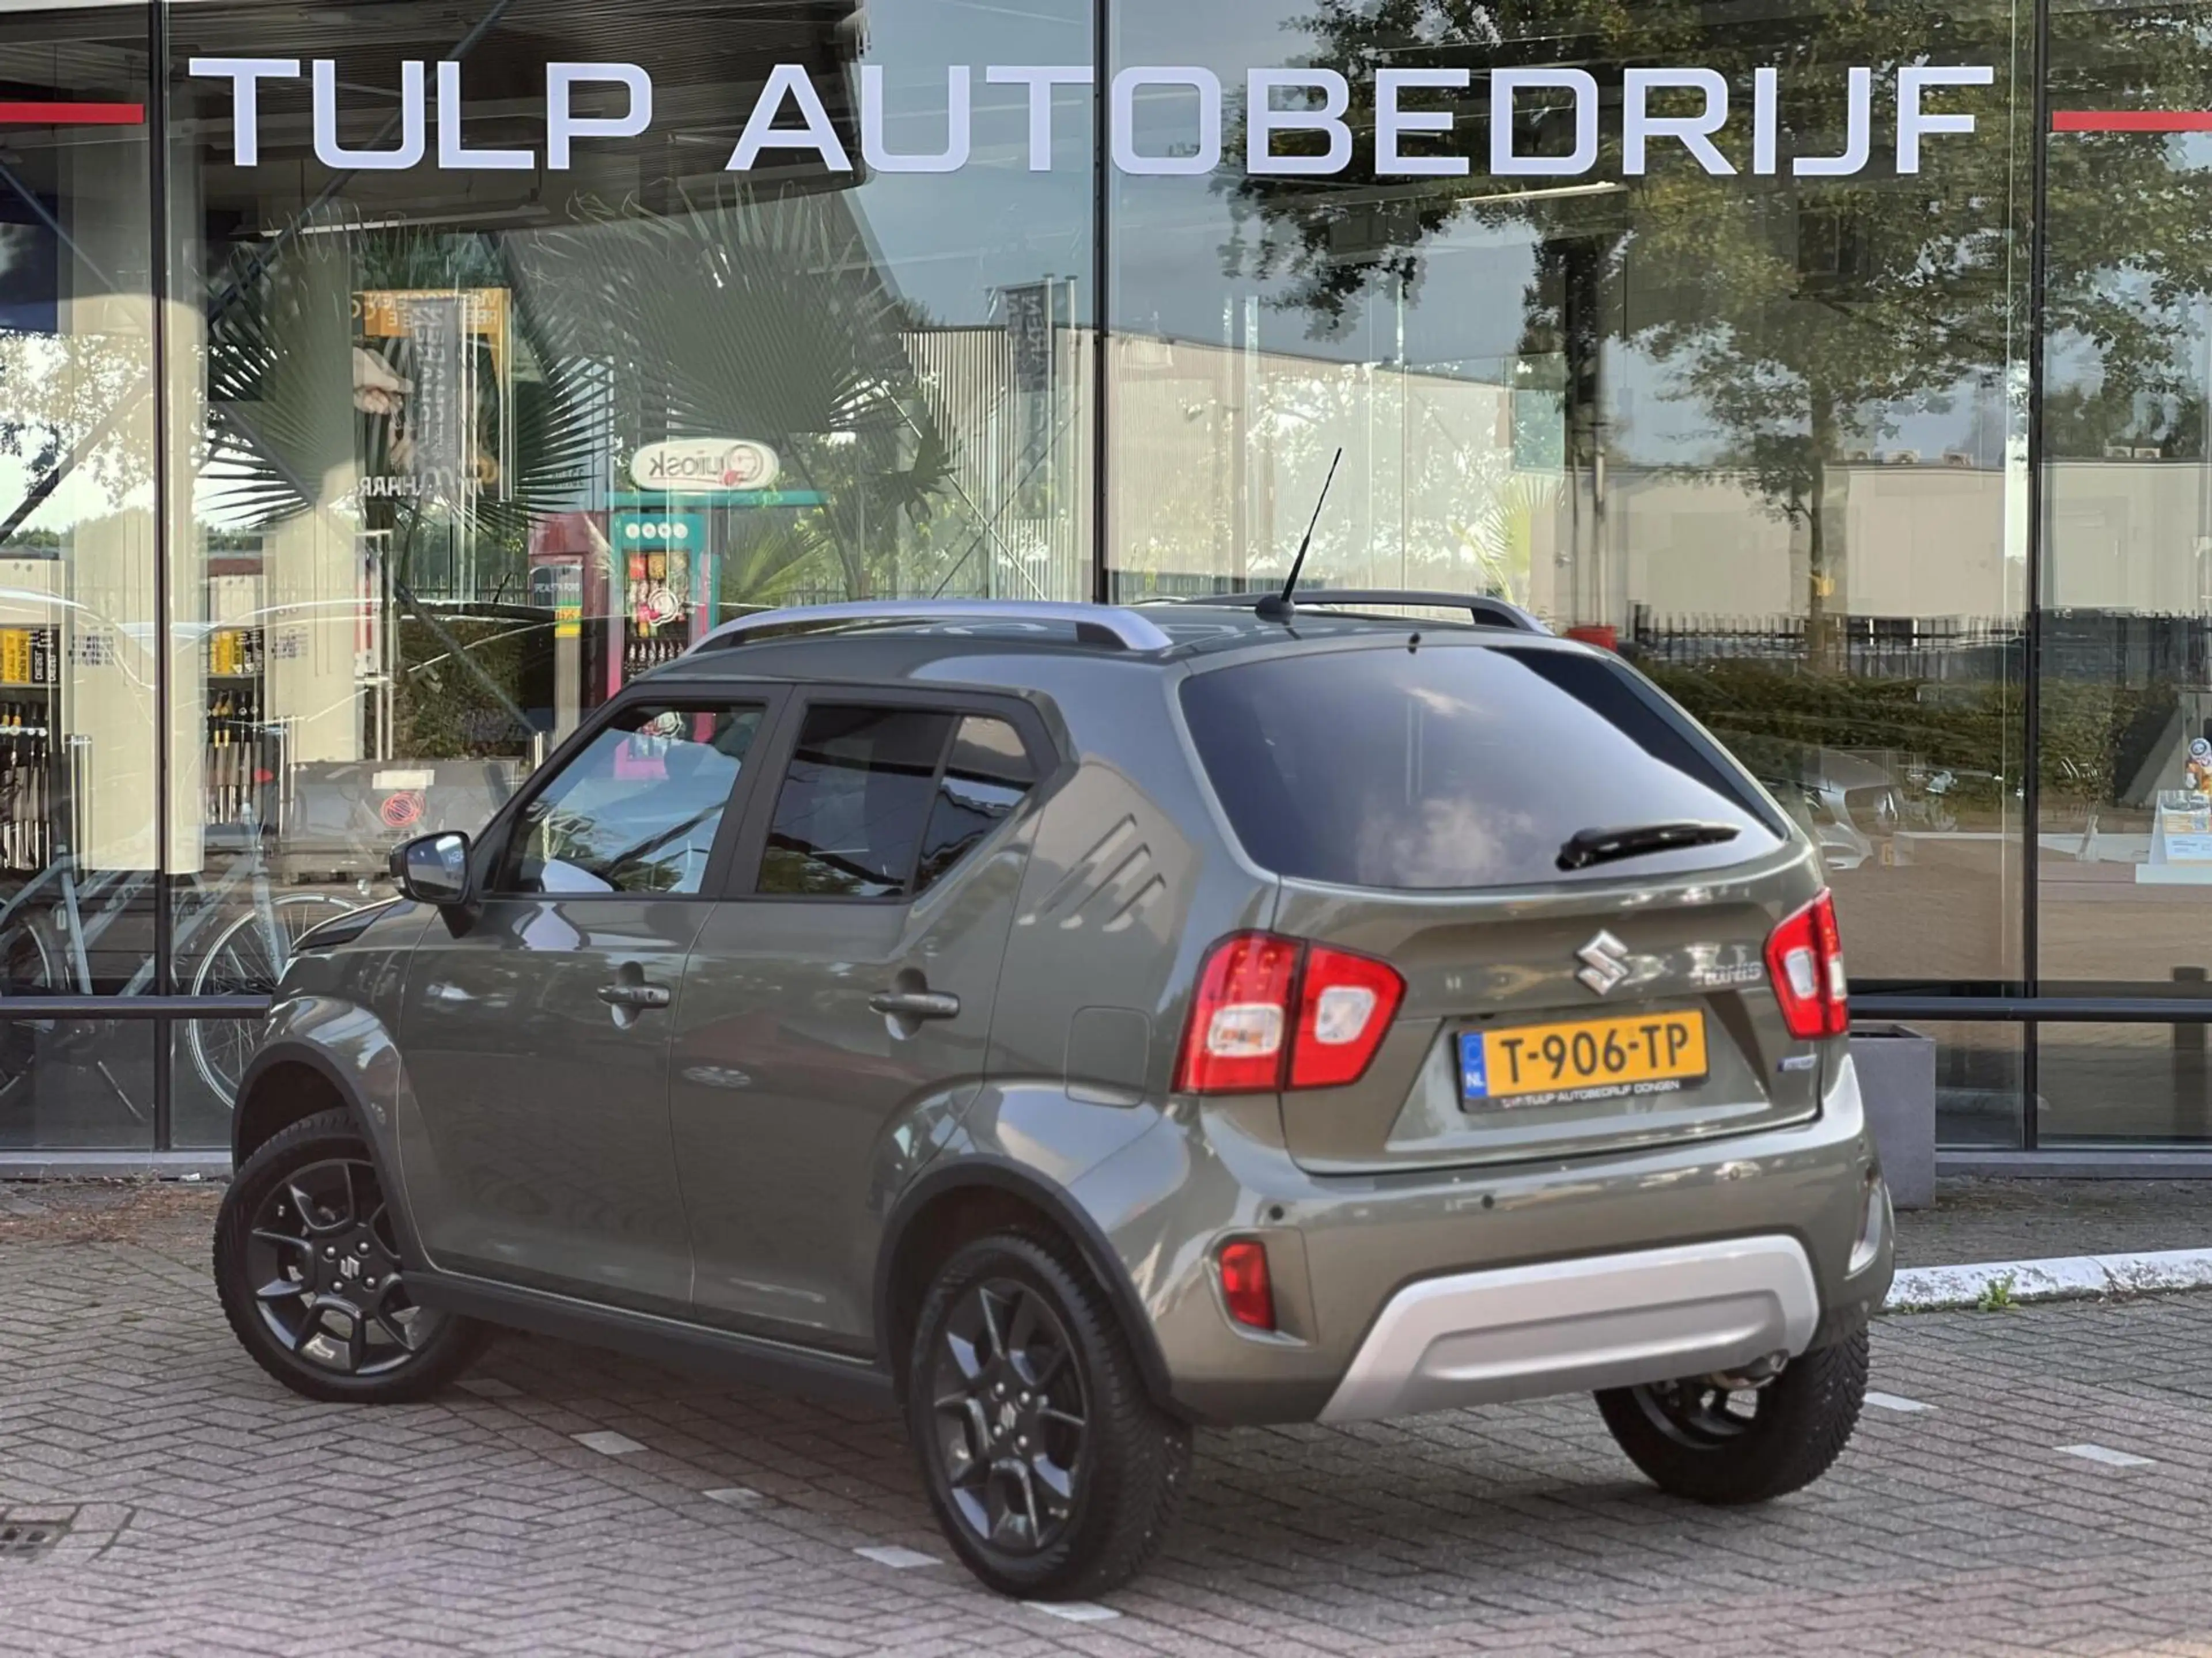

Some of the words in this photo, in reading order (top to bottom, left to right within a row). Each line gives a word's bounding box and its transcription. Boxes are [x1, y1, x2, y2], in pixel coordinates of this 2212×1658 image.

[190, 58, 652, 169] TULP
[725, 65, 1994, 176] AUTOBEDRIJF
[1500, 1022, 1689, 1084] T-906-TP
[1465, 1072, 1484, 1088] NL
[1527, 1094, 1556, 1106] TULP
[1557, 1085, 1632, 1102] AUTOBEDRIJF
[1634, 1080, 1680, 1094] DONGEN
